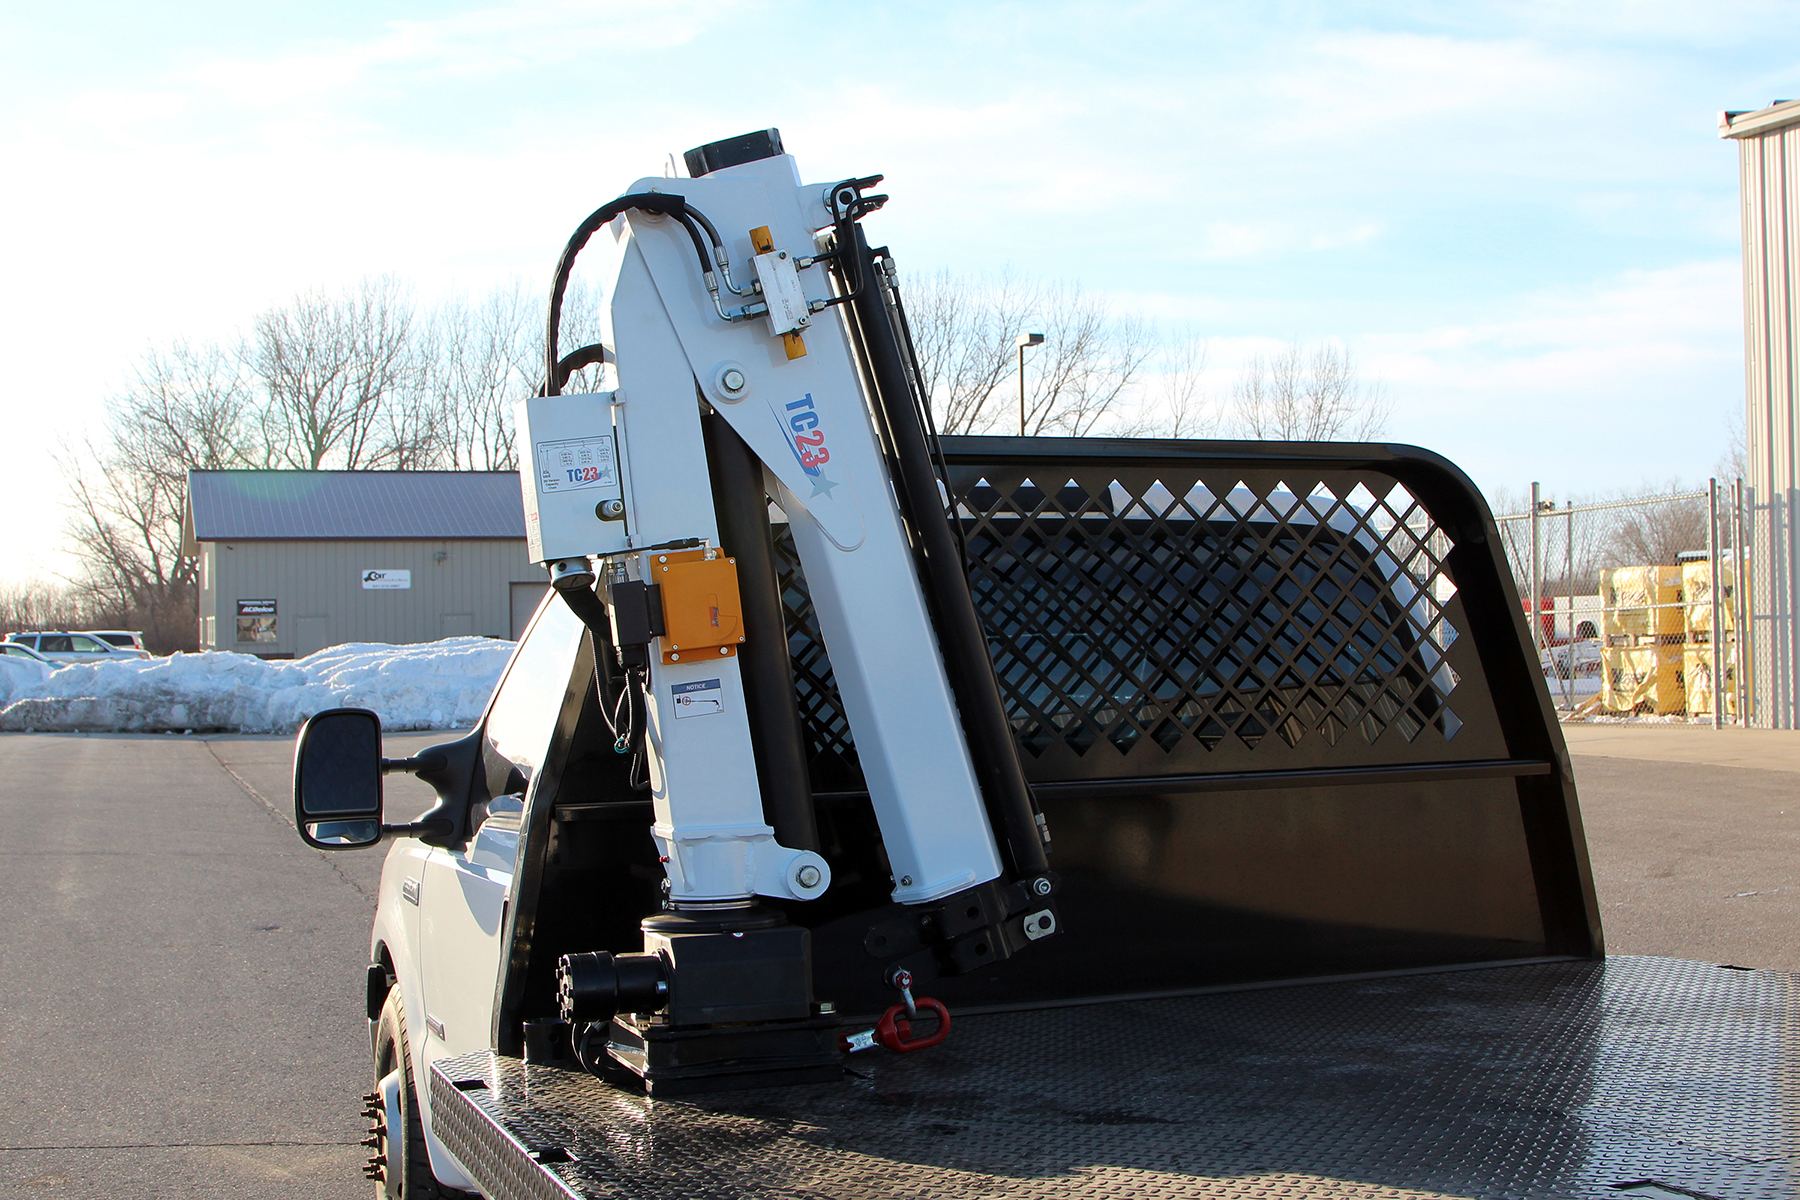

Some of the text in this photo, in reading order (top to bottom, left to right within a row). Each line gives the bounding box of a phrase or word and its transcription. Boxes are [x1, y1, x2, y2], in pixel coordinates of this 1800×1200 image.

[785, 393, 830, 468] TC23
[566, 467, 599, 483] TC23
[686, 683, 707, 691] NOTICE
